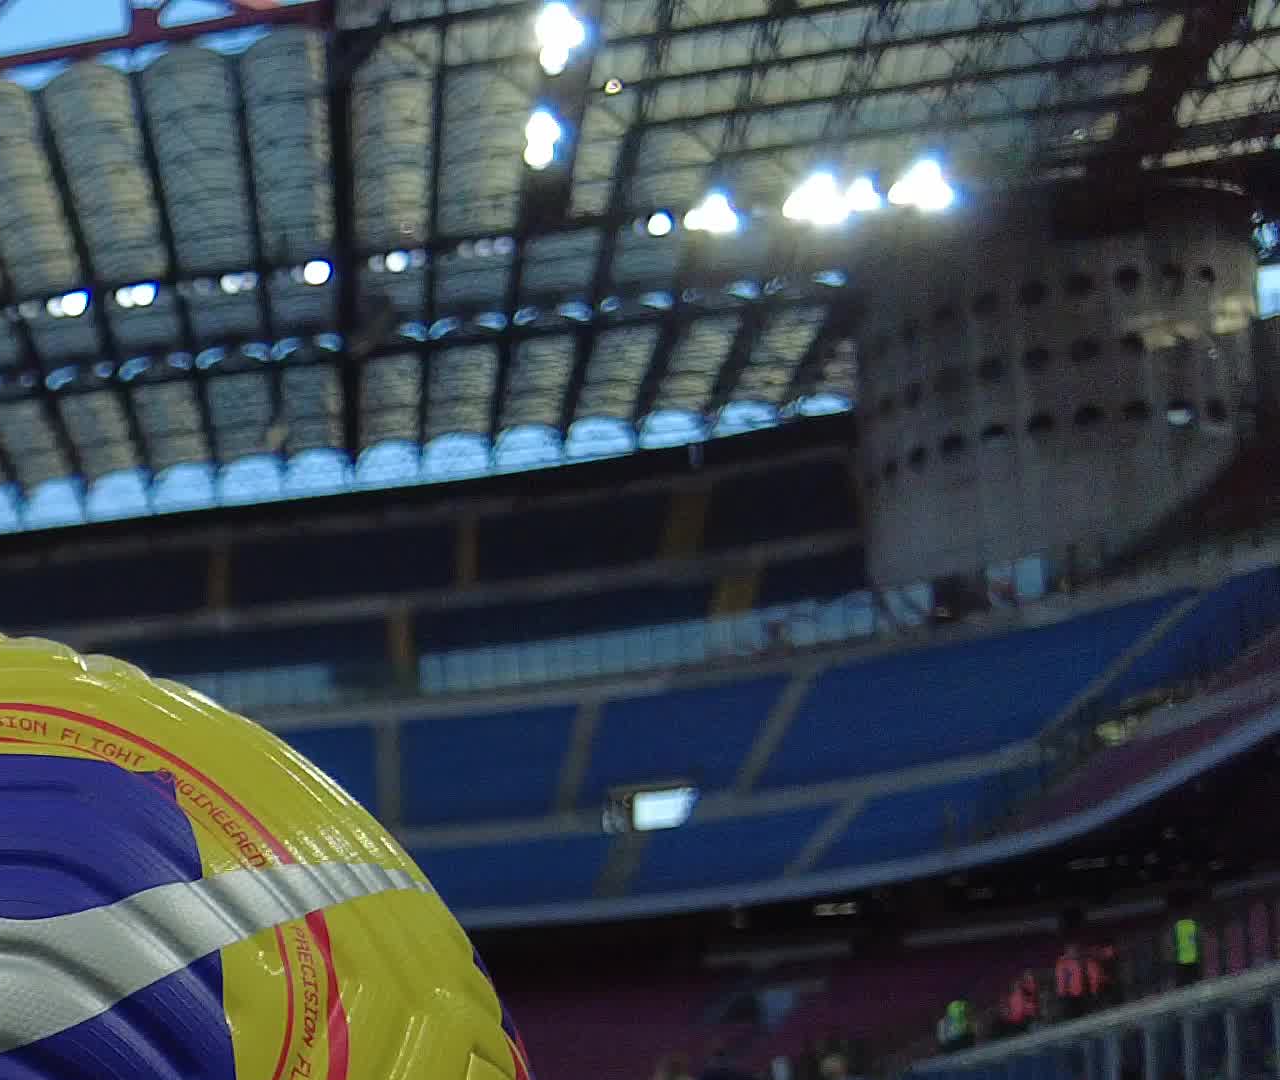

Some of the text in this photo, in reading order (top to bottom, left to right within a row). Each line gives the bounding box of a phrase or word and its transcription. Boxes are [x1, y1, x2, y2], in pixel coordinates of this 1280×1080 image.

[60, 726, 146, 767] FLIGHT
[154, 766, 268, 868] ENGINEERED
[289, 925, 320, 1048] PRECISION
